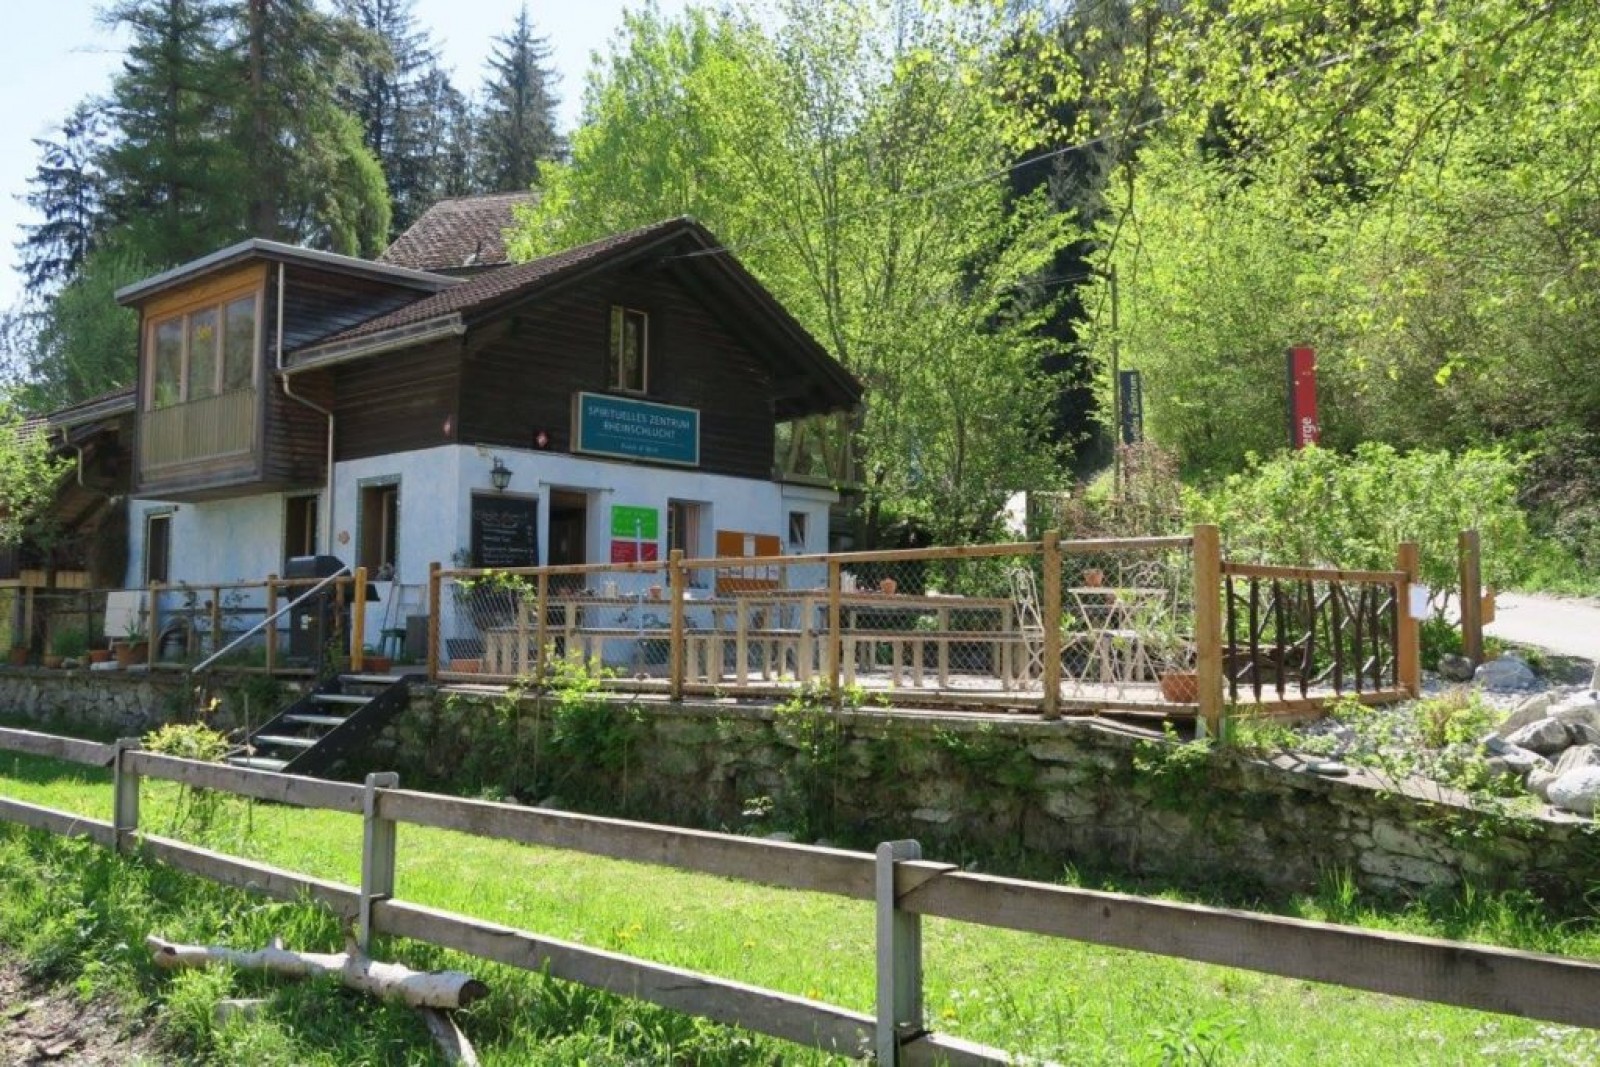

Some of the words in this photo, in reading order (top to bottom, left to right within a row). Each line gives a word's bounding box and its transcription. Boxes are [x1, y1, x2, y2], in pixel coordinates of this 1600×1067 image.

[588, 406, 647, 422] SPIRITUELLES
[649, 414, 690, 430] ZENTRUM
[604, 420, 676, 439] RHEINSCHLUCHT
[1303, 416, 1316, 444] erge
